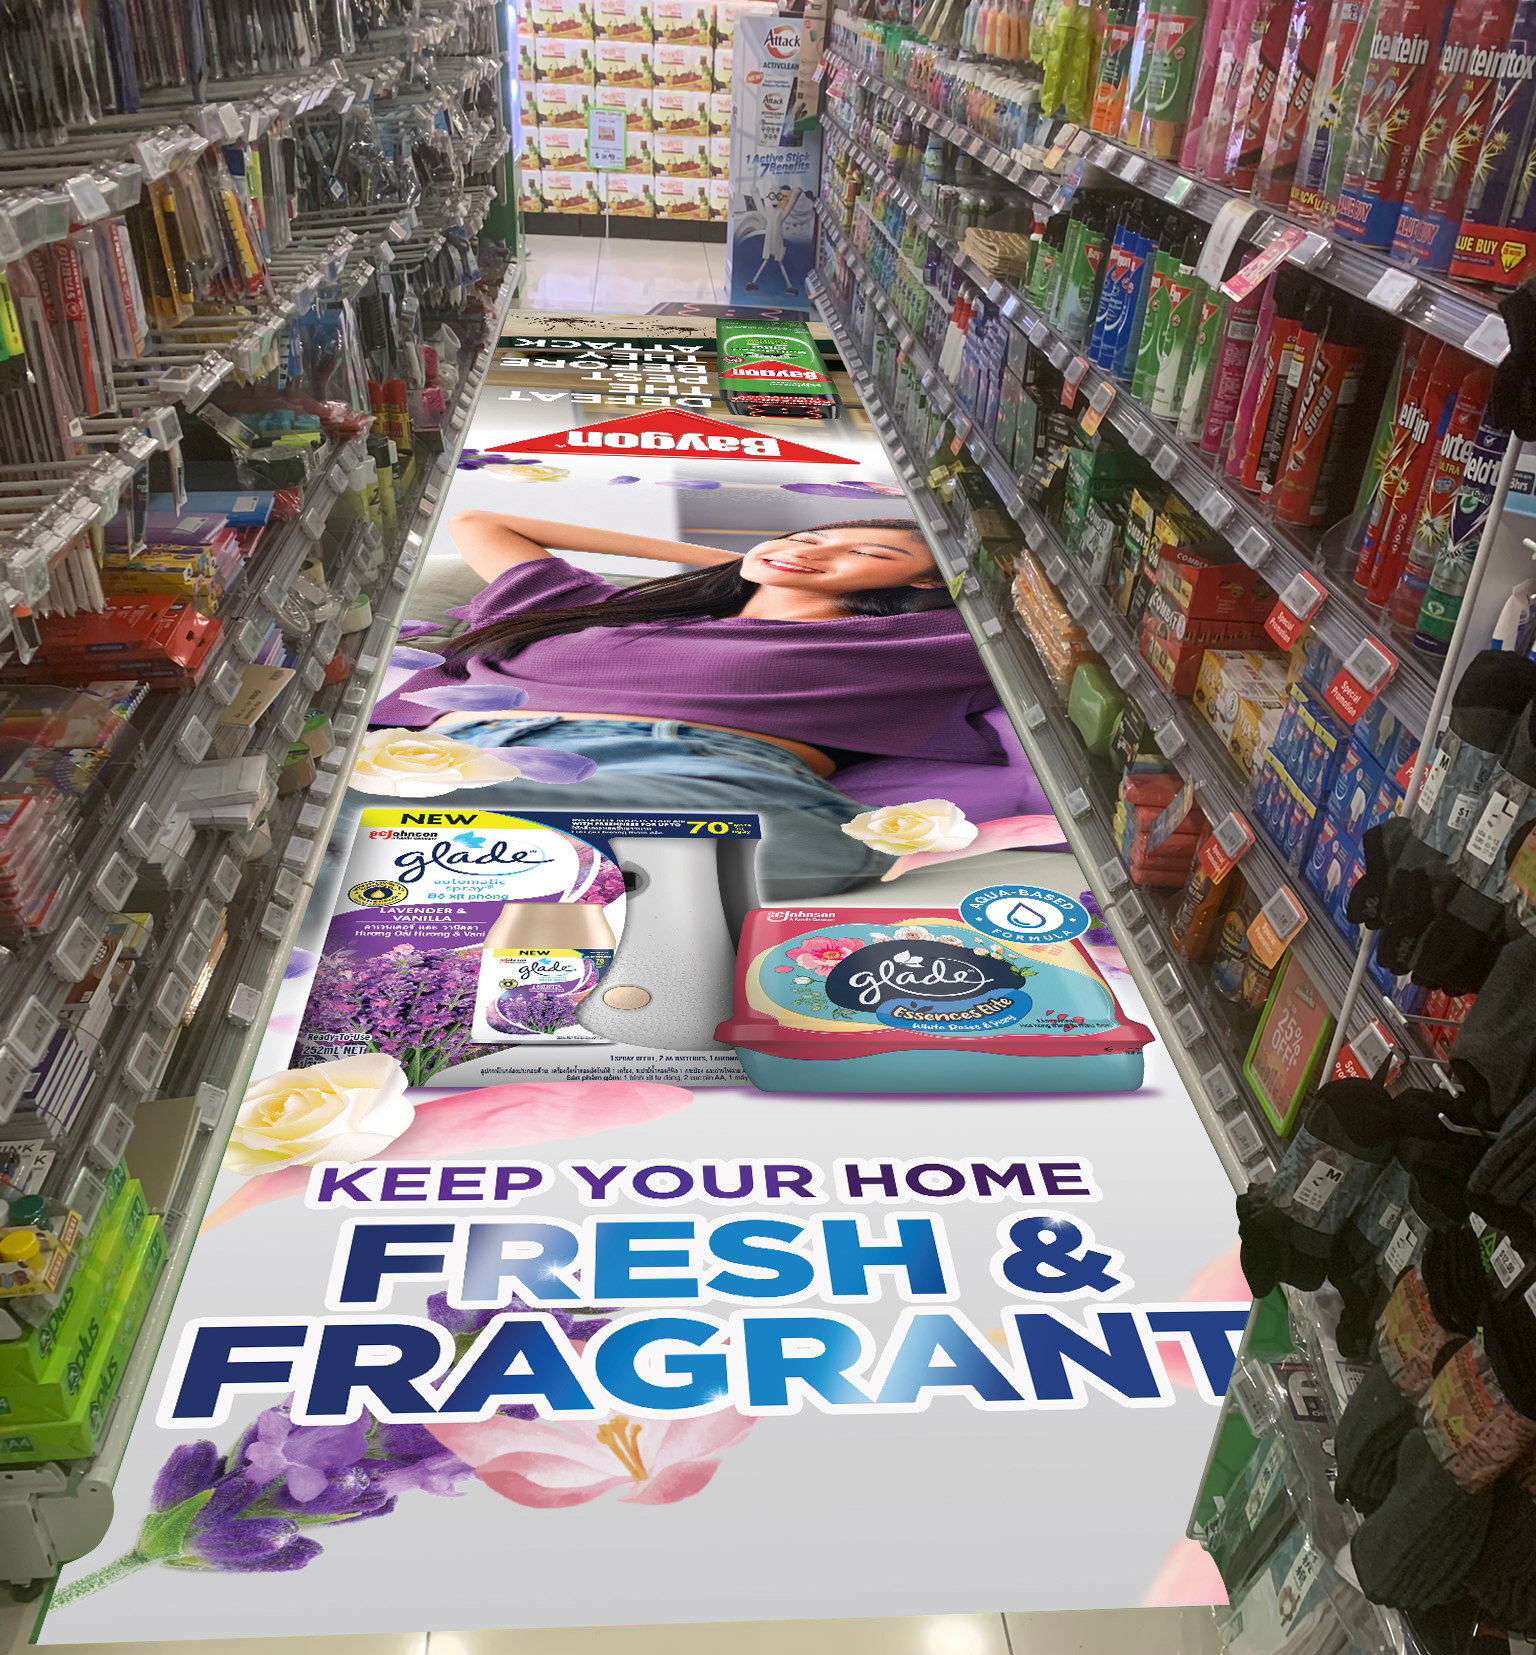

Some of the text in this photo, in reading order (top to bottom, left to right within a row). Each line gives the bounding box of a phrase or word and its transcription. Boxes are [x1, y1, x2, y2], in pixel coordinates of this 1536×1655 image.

[763, 28, 801, 48] Attack
[762, 94, 784, 105] Attack
[752, 153, 784, 164] Active
[786, 152, 810, 163] Stick
[760, 163, 770, 177] 7
[769, 161, 810, 172] Benefits
[1475, 238, 1498, 255] BUY
[514, 338, 704, 353] ATTACK
[499, 356, 707, 373] BEFORE
[574, 350, 708, 363] THEY
[580, 371, 709, 384] PEST
[732, 368, 819, 381] Baygon
[608, 383, 713, 396] THE
[497, 390, 713, 408] DEFEAT
[566, 430, 782, 457] Baygon
[1269, 616, 1292, 644] Promotion
[1277, 611, 1294, 632] Special
[1339, 680, 1361, 704] Special
[1331, 687, 1357, 717] Promotion
[1502, 799, 1514, 819] L
[400, 813, 478, 825] NEW
[686, 821, 729, 834] 70
[394, 841, 555, 883] glade
[968, 887, 1076, 912] AQUA-BASED
[991, 928, 1074, 945] FORMULA
[518, 961, 577, 980] glade
[848, 950, 995, 1004] glade
[893, 997, 1012, 1022] Essences Elite
[307, 1033, 371, 1042] Ready-To-Use
[303, 1045, 340, 1055] 252mL
[317, 1163, 1090, 1203] KEEP YOUR HOME
[1325, 1168, 1342, 1182] M
[339, 1217, 1122, 1305] FRESH &
[173, 1311, 1250, 1419] FRAGRANT
